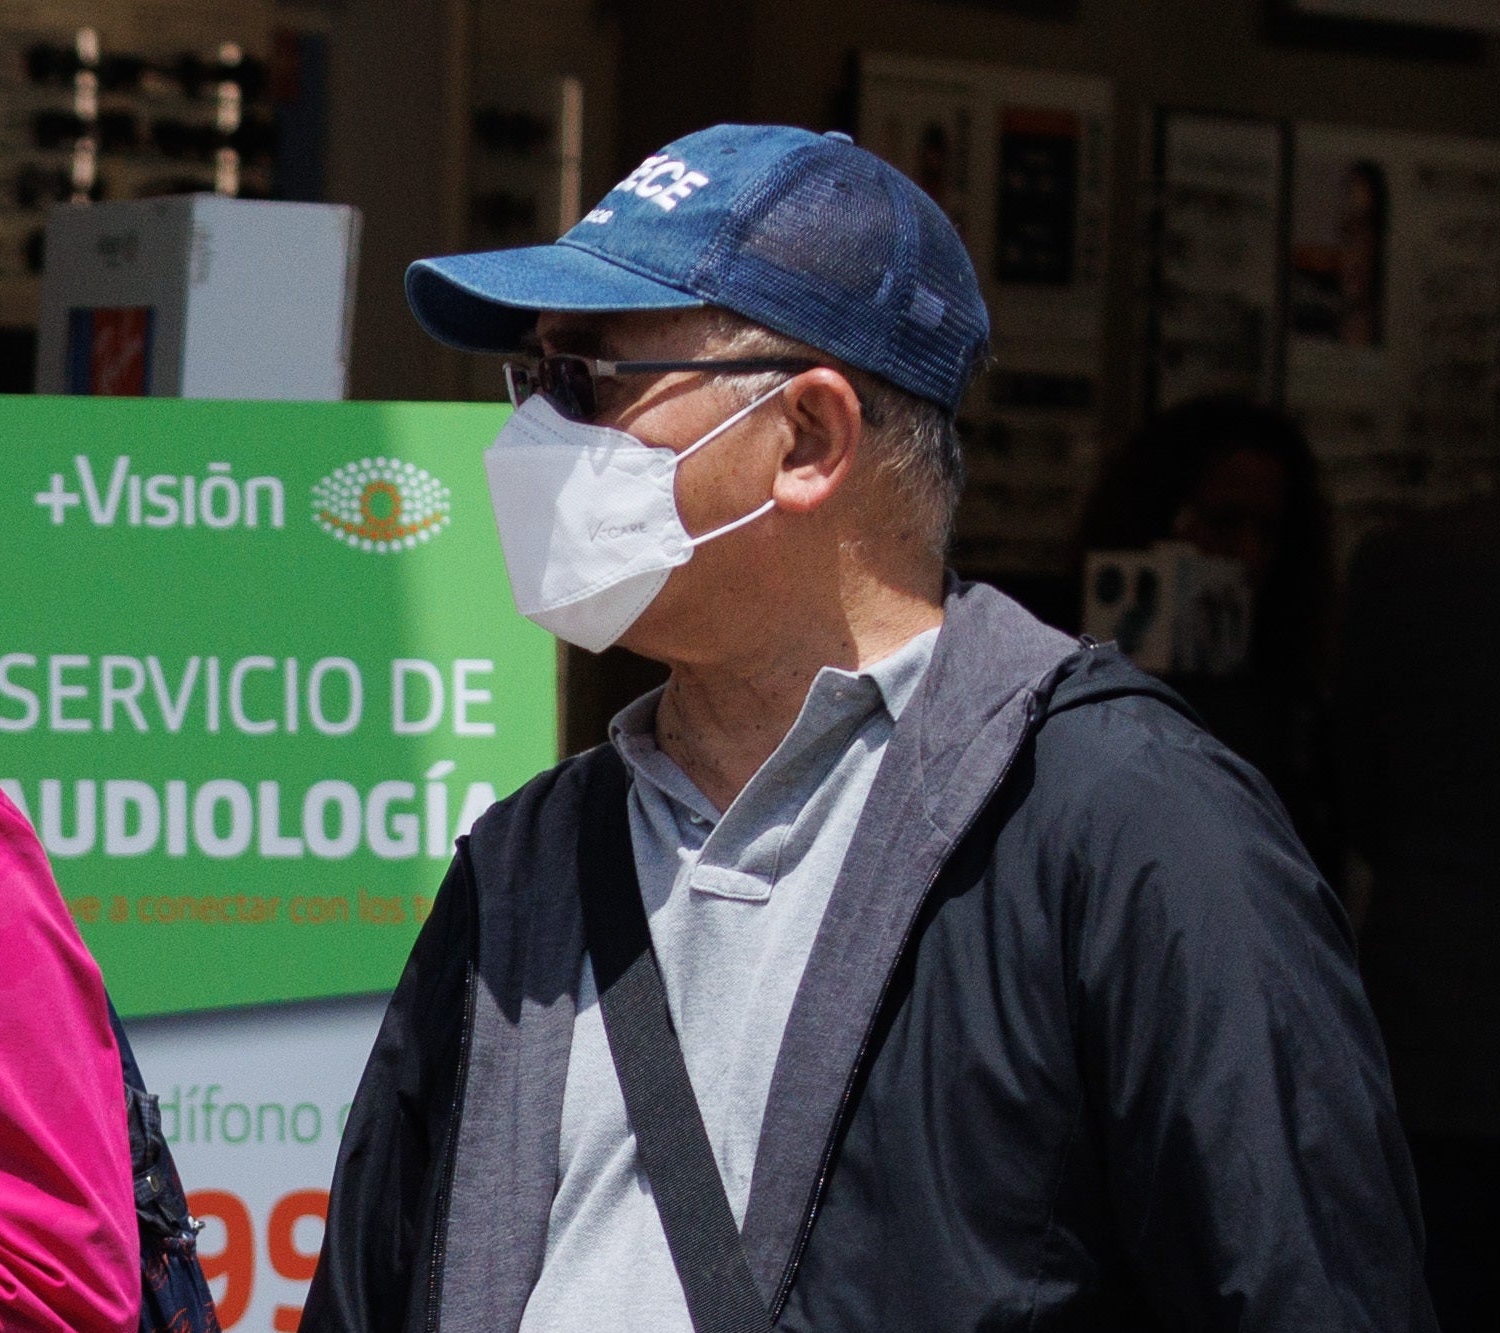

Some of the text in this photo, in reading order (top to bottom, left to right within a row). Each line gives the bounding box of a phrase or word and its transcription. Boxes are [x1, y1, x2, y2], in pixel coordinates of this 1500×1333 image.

[392, 659, 496, 737] DE
[138, 893, 281, 923] conectar
[290, 896, 350, 923] con
[357, 887, 407, 923] los
